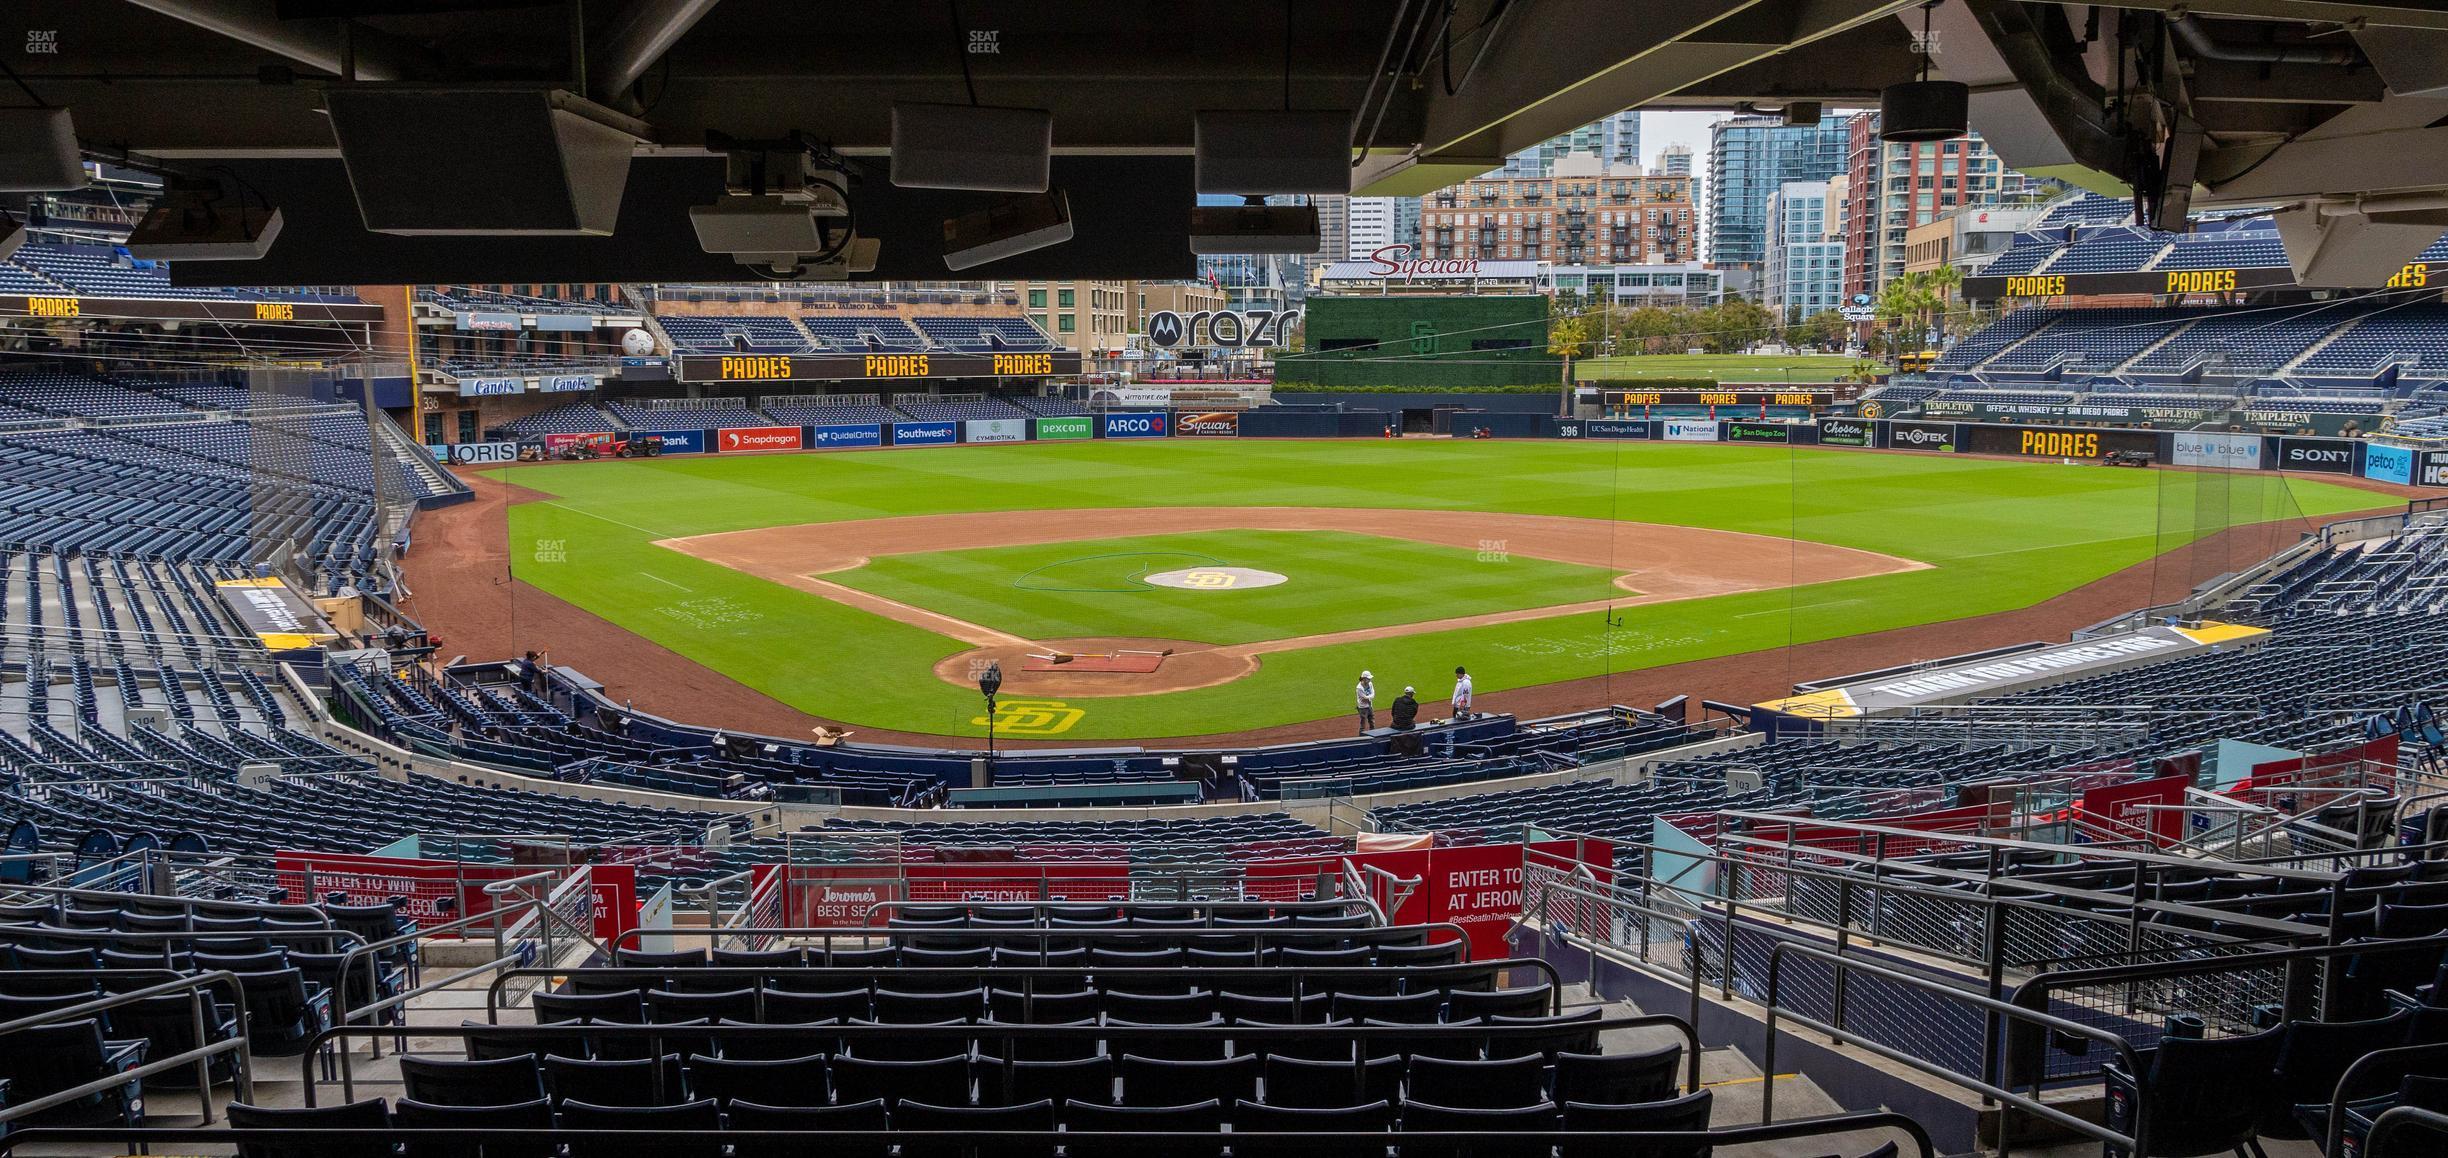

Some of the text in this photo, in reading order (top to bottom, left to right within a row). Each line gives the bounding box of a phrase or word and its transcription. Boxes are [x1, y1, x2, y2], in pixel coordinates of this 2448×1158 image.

[1368, 244, 1482, 285] Sycuan
[2006, 275, 2066, 296] PADRES
[2166, 271, 2237, 293] PADRES
[28, 297, 80, 317] PADRES
[255, 303, 294, 321] PADRES
[1843, 313, 1875, 321] Square
[1187, 309, 1300, 348] razr
[722, 356, 791, 379] PADRES
[866, 355, 929, 377] PADRES
[993, 353, 1052, 375] PADRES
[423, 396, 440, 410] 336
[1624, 393, 1661, 405] PADRES
[1700, 393, 1737, 405] PADRES
[1775, 393, 1813, 405] PADRES
[1925, 400, 1974, 413] TEMPLETON
[2018, 405, 2051, 414] WHISKEY
[2067, 407, 2081, 415] SAN
[2082, 407, 2101, 416] DIEGO
[2102, 408, 2130, 417] PADRES
[2141, 408, 2203, 421] TEMPLETON
[2244, 411, 2311, 424] TEMPLETON
[1107, 419, 1150, 432] ARCO
[1179, 415, 1232, 435] Sycuan
[1591, 425, 1644, 434] UC San Diego Health
[1683, 425, 1715, 433] National
[1823, 421, 1862, 435] Chosen
[830, 430, 878, 440] QuidelOrtho
[897, 428, 945, 439] Southwest
[1561, 426, 1578, 438] 396
[1743, 429, 1755, 437] San
[1755, 429, 1772, 439] Diego
[742, 434, 797, 445] Snapdragon
[2021, 430, 2098, 458] PADRES
[458, 444, 515, 463] ORIS
[2176, 441, 2202, 454] blue
[2217, 443, 2245, 456] blue
[2289, 449, 2349, 463] SONY
[2368, 453, 2395, 471] petco
[2430, 452, 2448, 464] HU
[137, 716, 156, 726] 104
[1735, 779, 1750, 791] 103
[313, 869, 417, 892] ENTER TO WIN
[1448, 869, 1500, 889] ENTER
[1503, 867, 1523, 885] TO
[1447, 893, 1469, 911] AT
[817, 905, 848, 918] BEST
